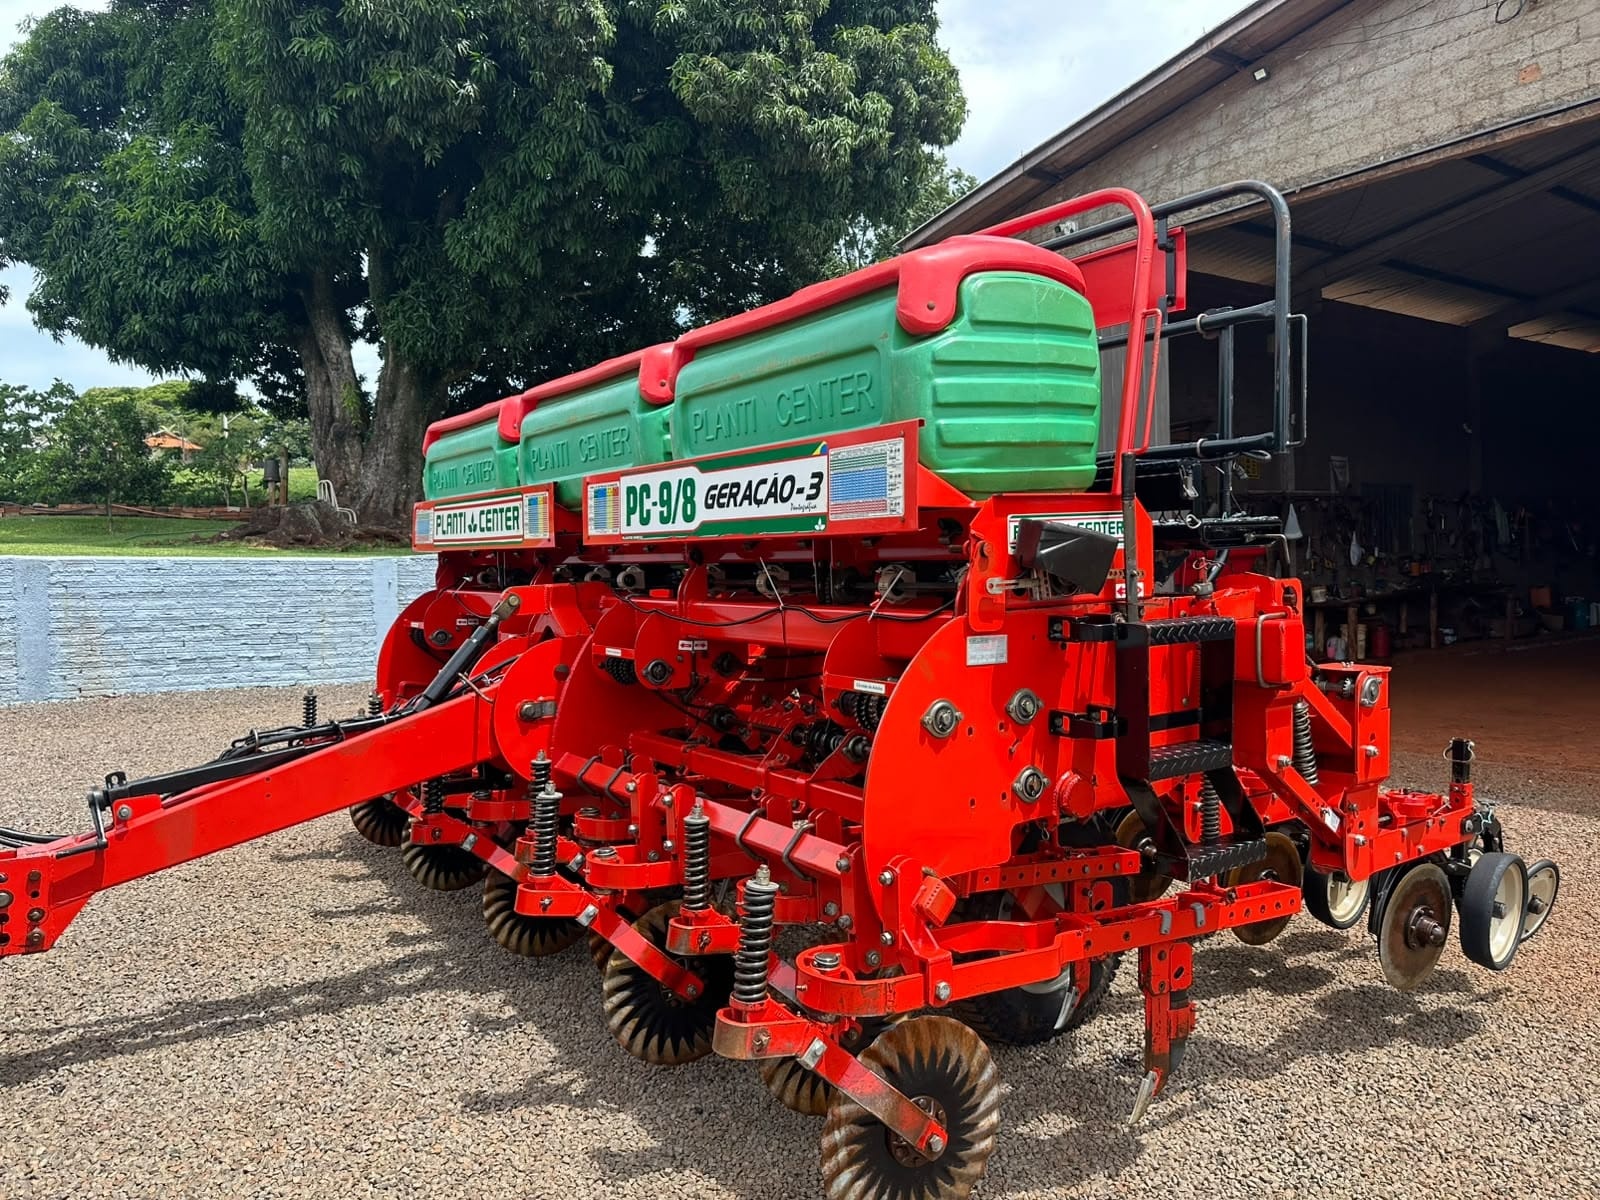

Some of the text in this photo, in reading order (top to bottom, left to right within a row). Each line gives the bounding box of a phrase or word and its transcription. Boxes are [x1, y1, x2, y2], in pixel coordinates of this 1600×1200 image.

[693, 370, 875, 443] PLANTI CENTER
[462, 459, 496, 486] CENTER
[531, 426, 632, 473] PLANTI CENTER
[435, 511, 466, 536] PLANTI
[479, 505, 520, 533] CENTER
[626, 477, 696, 527] PC-9/8
[704, 471, 824, 509] GERAÇÃO-3
